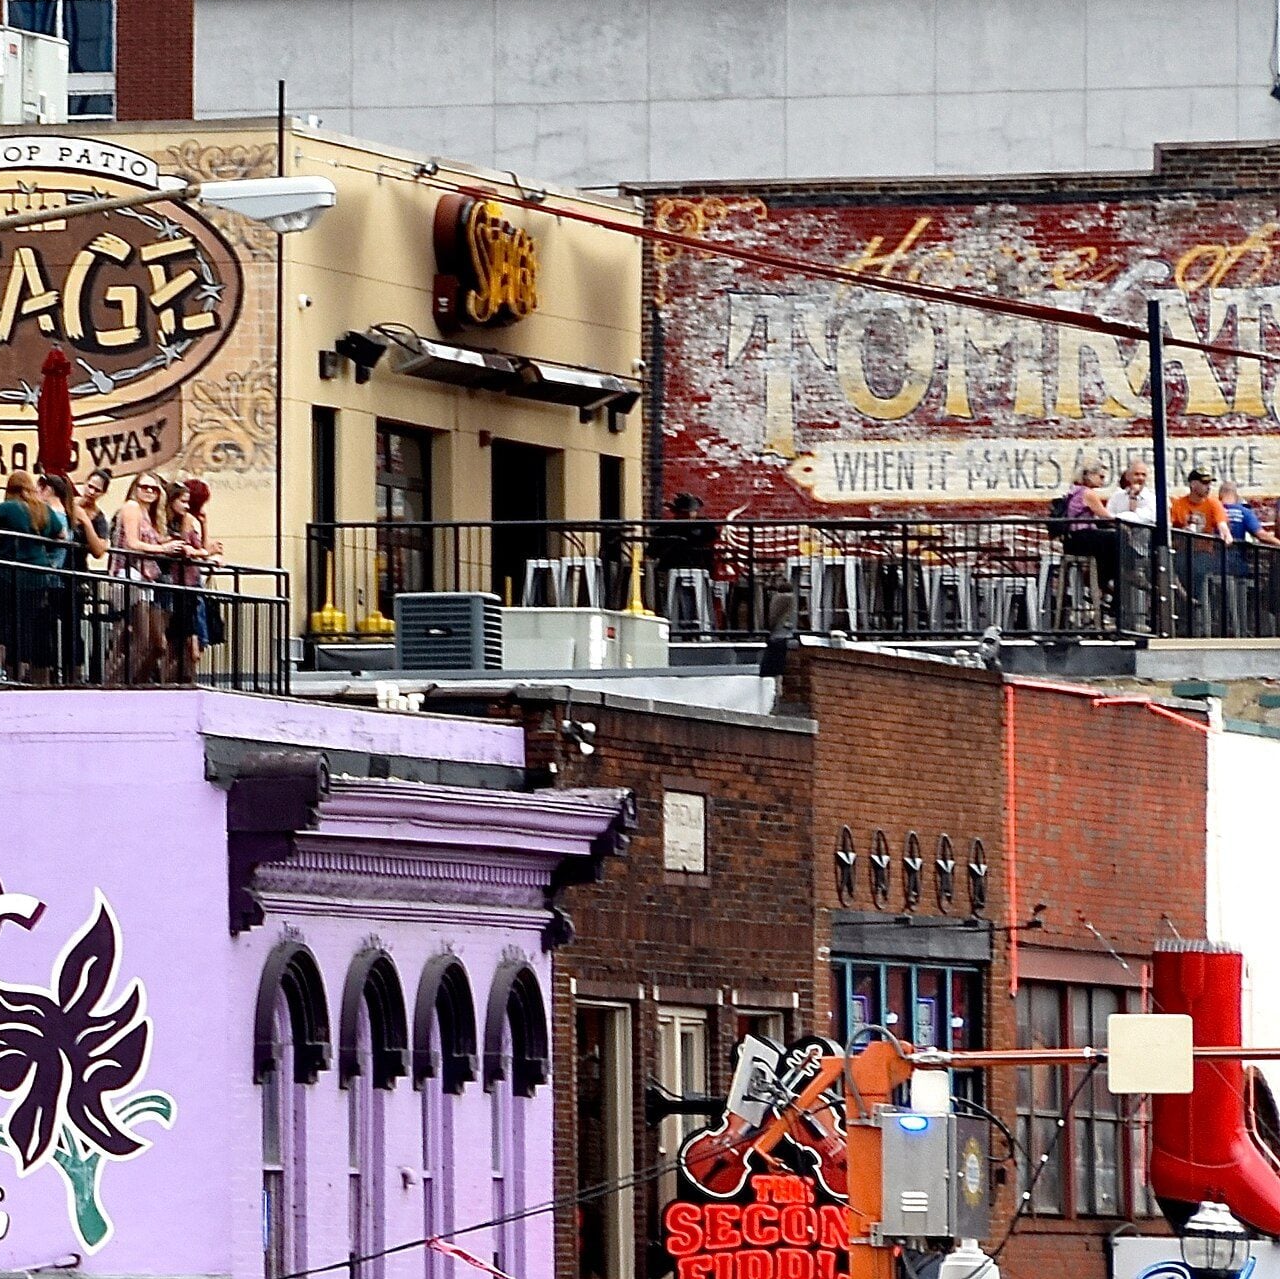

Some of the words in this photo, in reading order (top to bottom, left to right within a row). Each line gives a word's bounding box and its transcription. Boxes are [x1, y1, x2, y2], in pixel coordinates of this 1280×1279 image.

[57, 146, 149, 177] PATIO
[832, 450, 914, 492] WHEN
[926, 451, 952, 491] IT
[967, 448, 1062, 491] MAKES
[751, 1174, 815, 1205] THE
[666, 1202, 850, 1256] SECON
